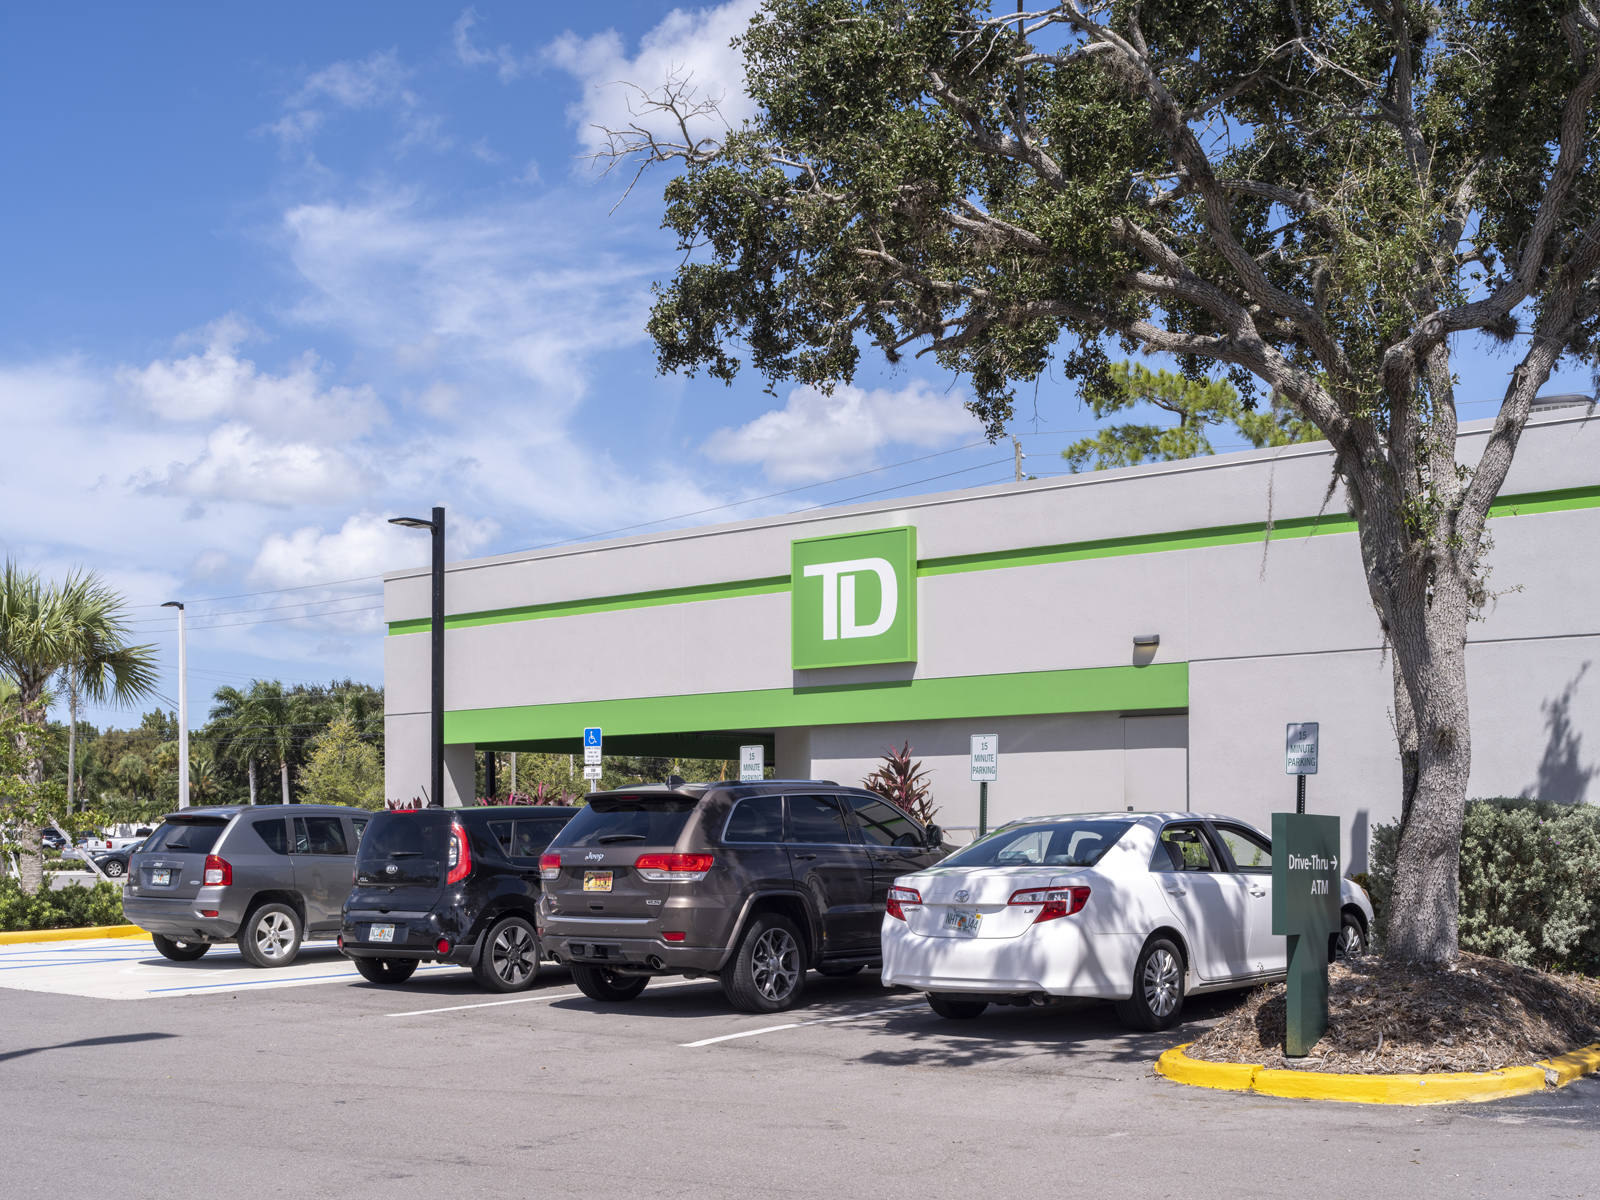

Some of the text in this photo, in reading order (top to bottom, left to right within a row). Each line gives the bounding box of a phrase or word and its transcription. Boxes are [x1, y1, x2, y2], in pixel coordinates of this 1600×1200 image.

[804, 557, 898, 640] TD
[1299, 731, 1307, 740] 15
[1290, 744, 1315, 753] MINUTE
[749, 752, 755, 760] 15
[974, 754, 995, 762] MINUTE
[1288, 758, 1316, 766] PARKING
[743, 763, 760, 771] MINUTE
[972, 766, 995, 774] PARKING
[585, 851, 604, 861] Jeep
[1289, 853, 1329, 870] Drive-Thru
[1311, 880, 1329, 895] ATM
